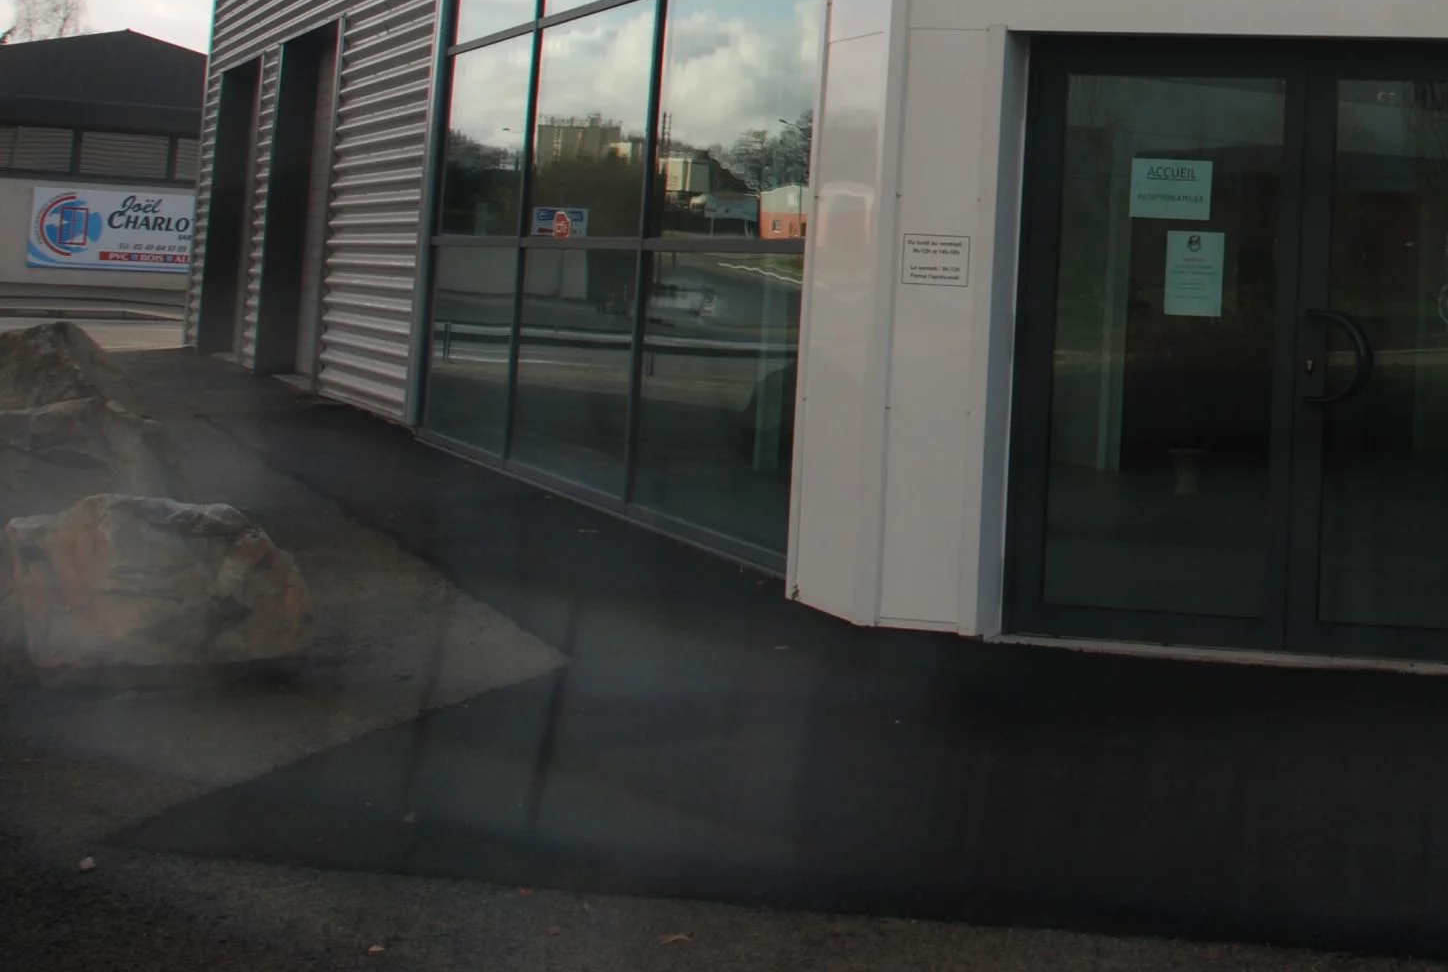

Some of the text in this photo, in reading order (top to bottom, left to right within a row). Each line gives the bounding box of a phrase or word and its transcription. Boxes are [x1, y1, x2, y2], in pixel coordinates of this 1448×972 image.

[1146, 166, 1197, 179] ACCUEIL
[121, 195, 162, 213] Joël
[107, 210, 194, 233] CHARLO
[108, 252, 129, 261] PVC
[139, 253, 164, 262] BOIS
